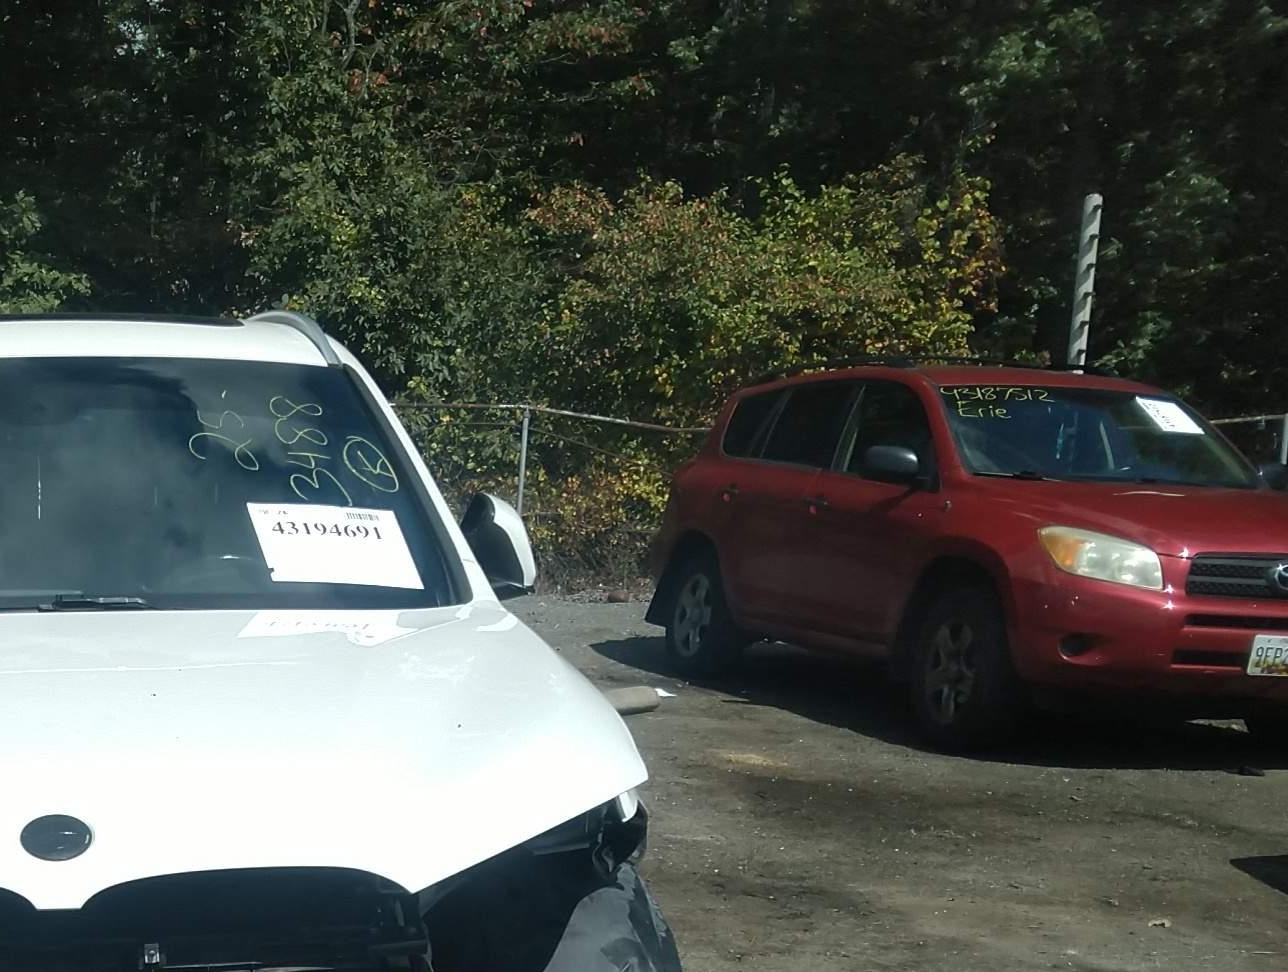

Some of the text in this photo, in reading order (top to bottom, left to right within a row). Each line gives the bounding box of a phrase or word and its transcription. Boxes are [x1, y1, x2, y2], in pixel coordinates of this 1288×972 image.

[939, 387, 1056, 402] 43187512
[956, 401, 1012, 419] Erie
[189, 410, 259, 471] 25
[269, 395, 353, 507] 3488
[271, 520, 383, 540] 43194691
